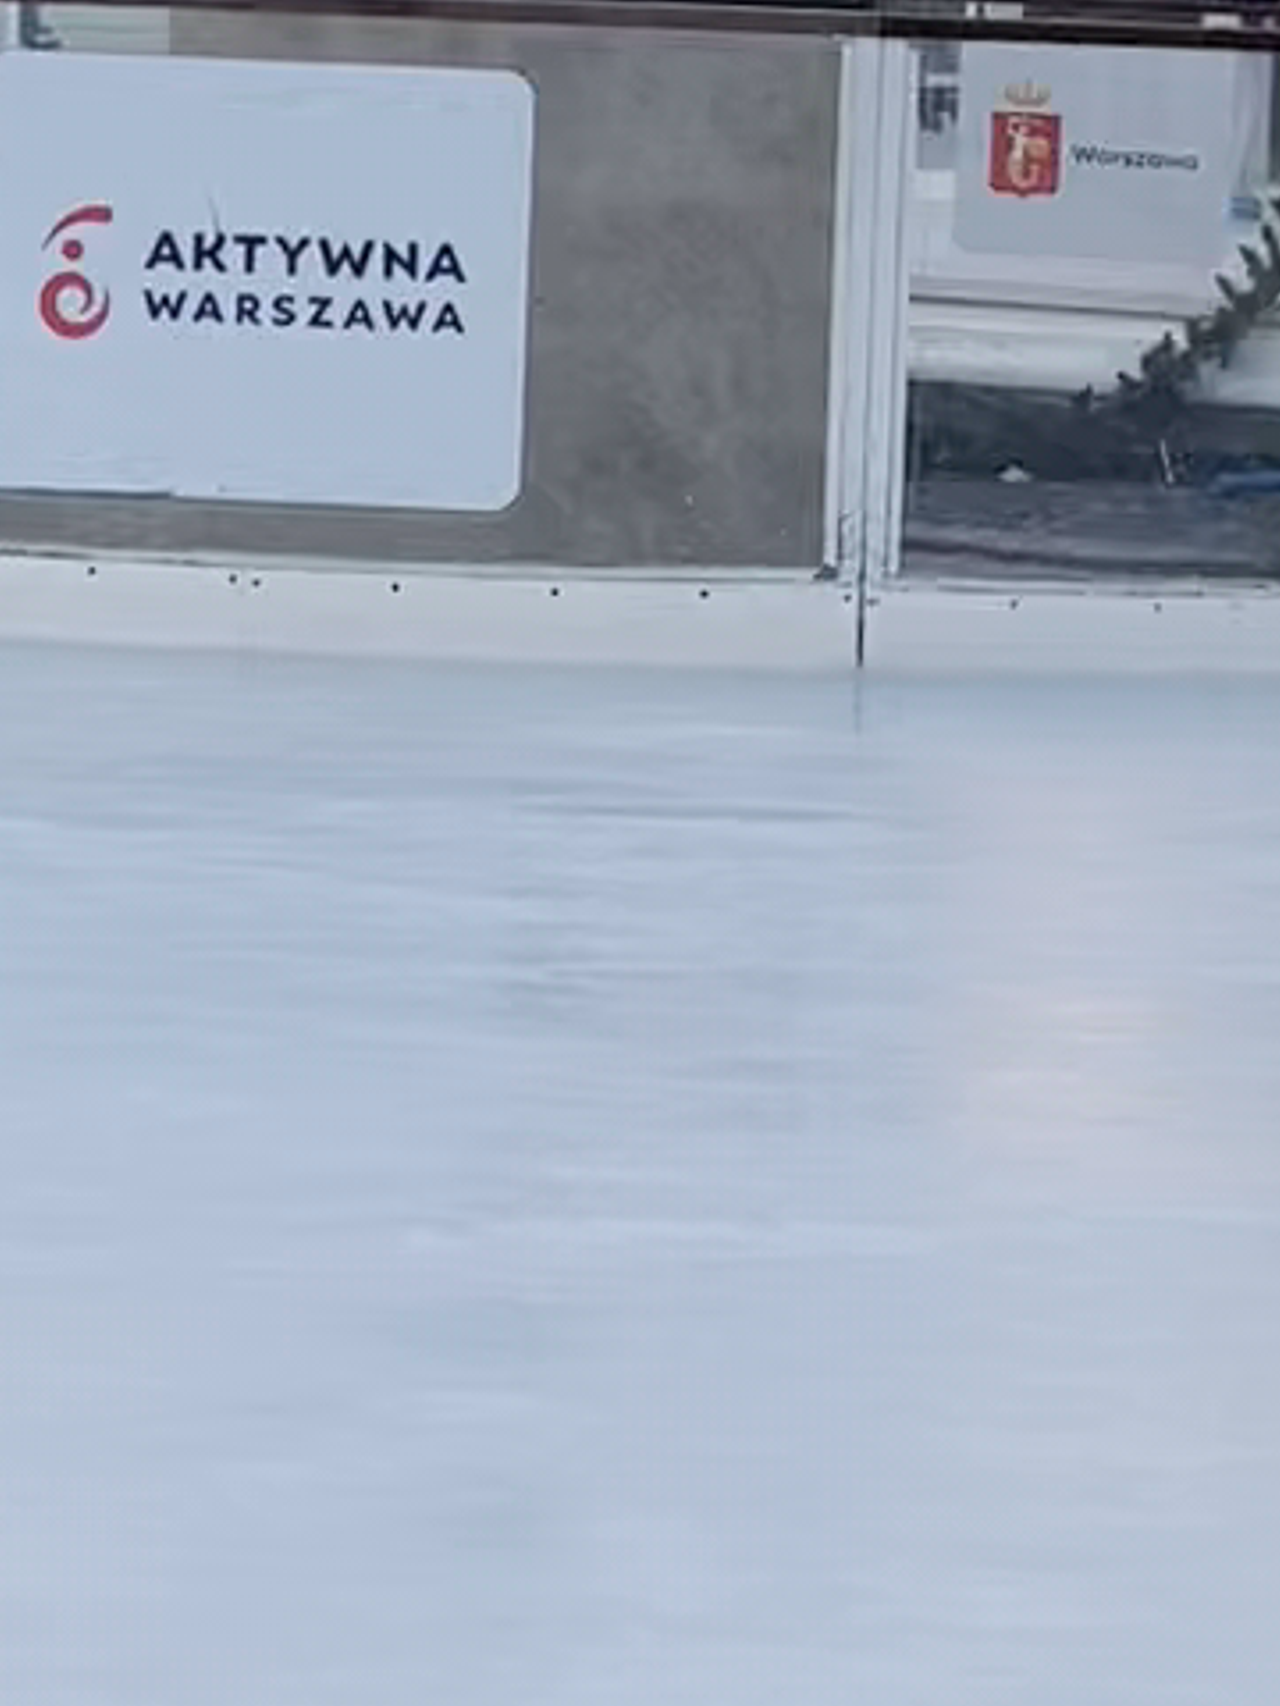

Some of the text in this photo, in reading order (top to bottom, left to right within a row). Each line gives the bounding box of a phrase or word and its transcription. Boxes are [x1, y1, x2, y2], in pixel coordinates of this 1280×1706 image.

[1070, 142, 1199, 170] Warszawa
[143, 230, 467, 284] AKTYWNA
[142, 288, 466, 335] WARSZAWA
